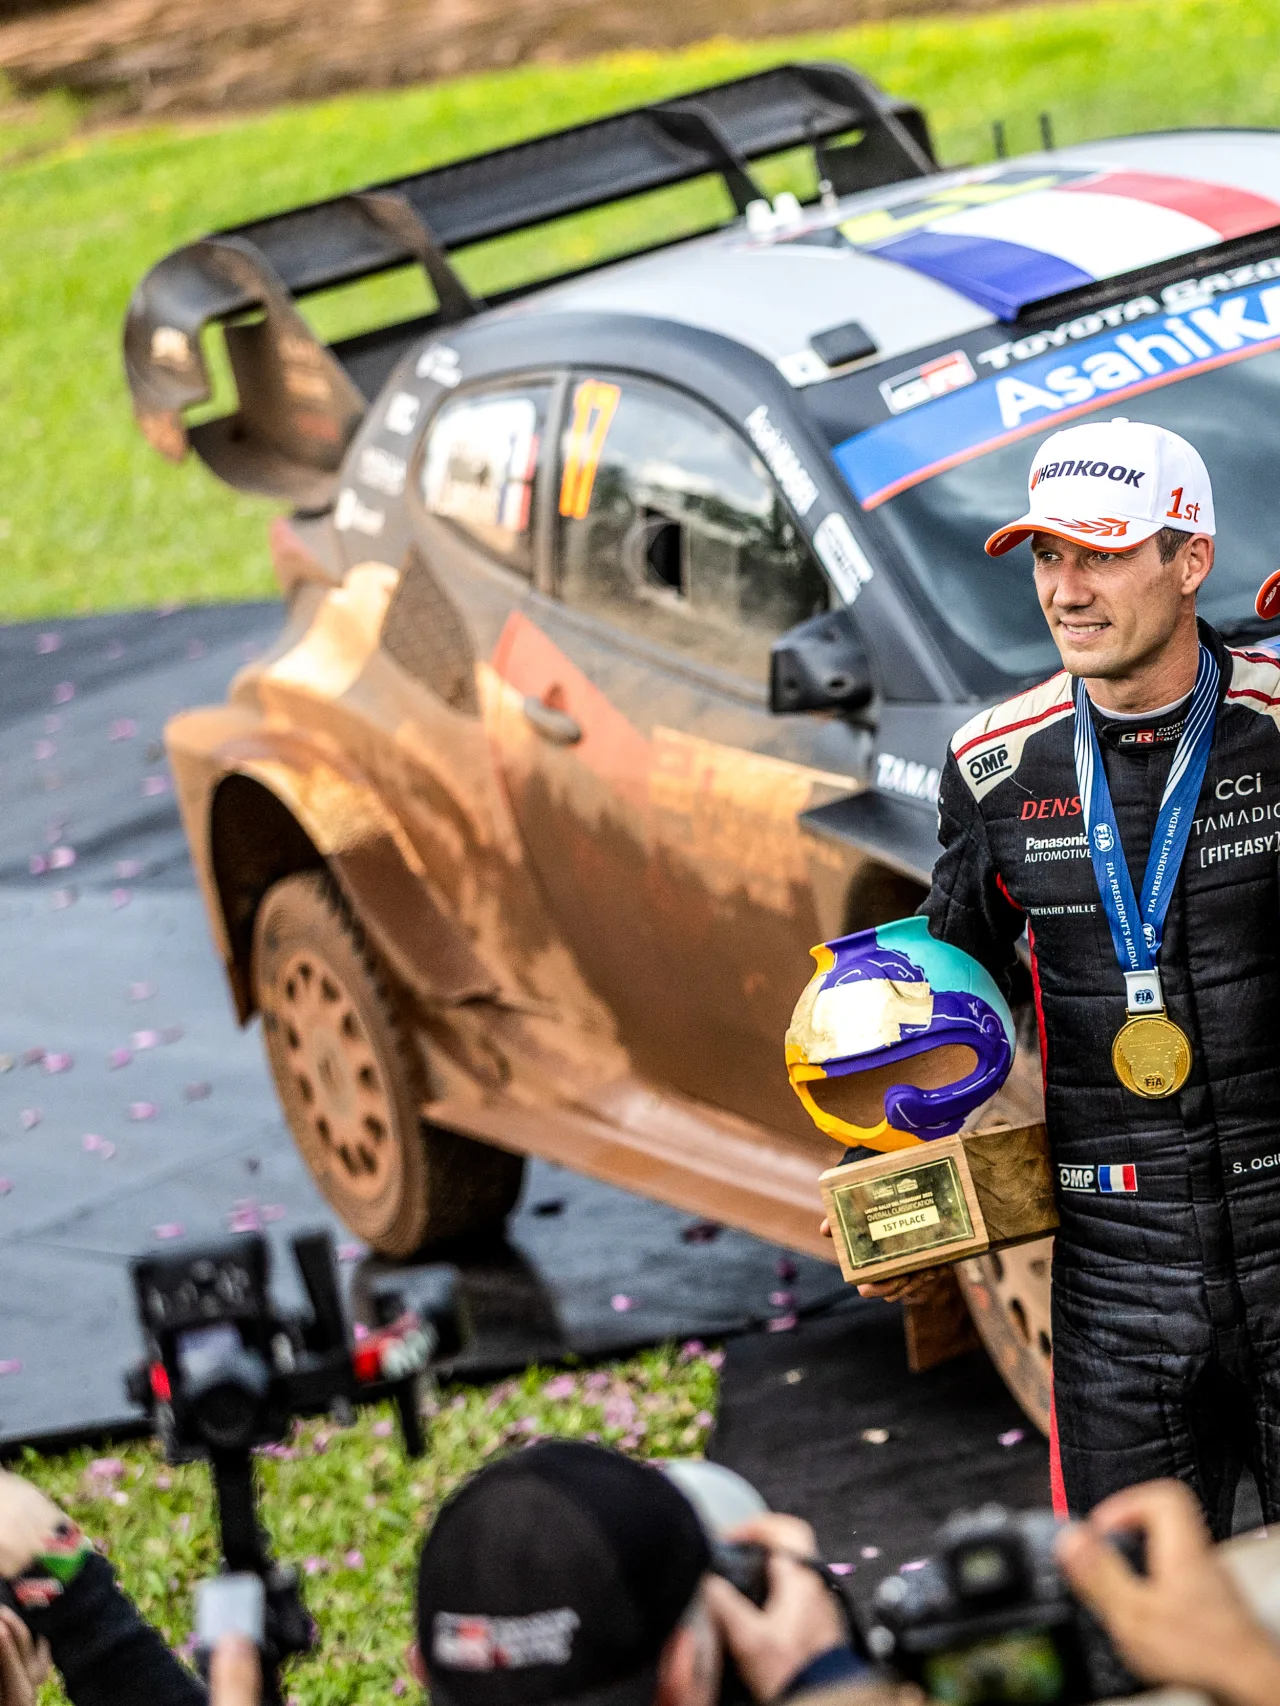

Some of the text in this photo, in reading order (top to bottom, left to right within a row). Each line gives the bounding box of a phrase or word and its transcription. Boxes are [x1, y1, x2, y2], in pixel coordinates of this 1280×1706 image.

[977, 295, 1160, 370] TOYOTA
[1166, 486, 1201, 524] 1st
[1120, 731, 1154, 744] GR
[969, 749, 1009, 779] OMP
[1020, 795, 1083, 821] DENS
[1166, 805, 1182, 838] MEDAL
[1025, 832, 1090, 851] Panasonic
[1024, 848, 1092, 864] AUTOMOTIVE
[1030, 904, 1097, 917] RICHARD MILLE
[1124, 937, 1140, 970] MEDAL
[1135, 991, 1153, 1002] FIA
[1232, 1161, 1248, 1174] S.
[1059, 1168, 1095, 1189] OMP
[882, 1213, 926, 1232] 1ST PLACE
